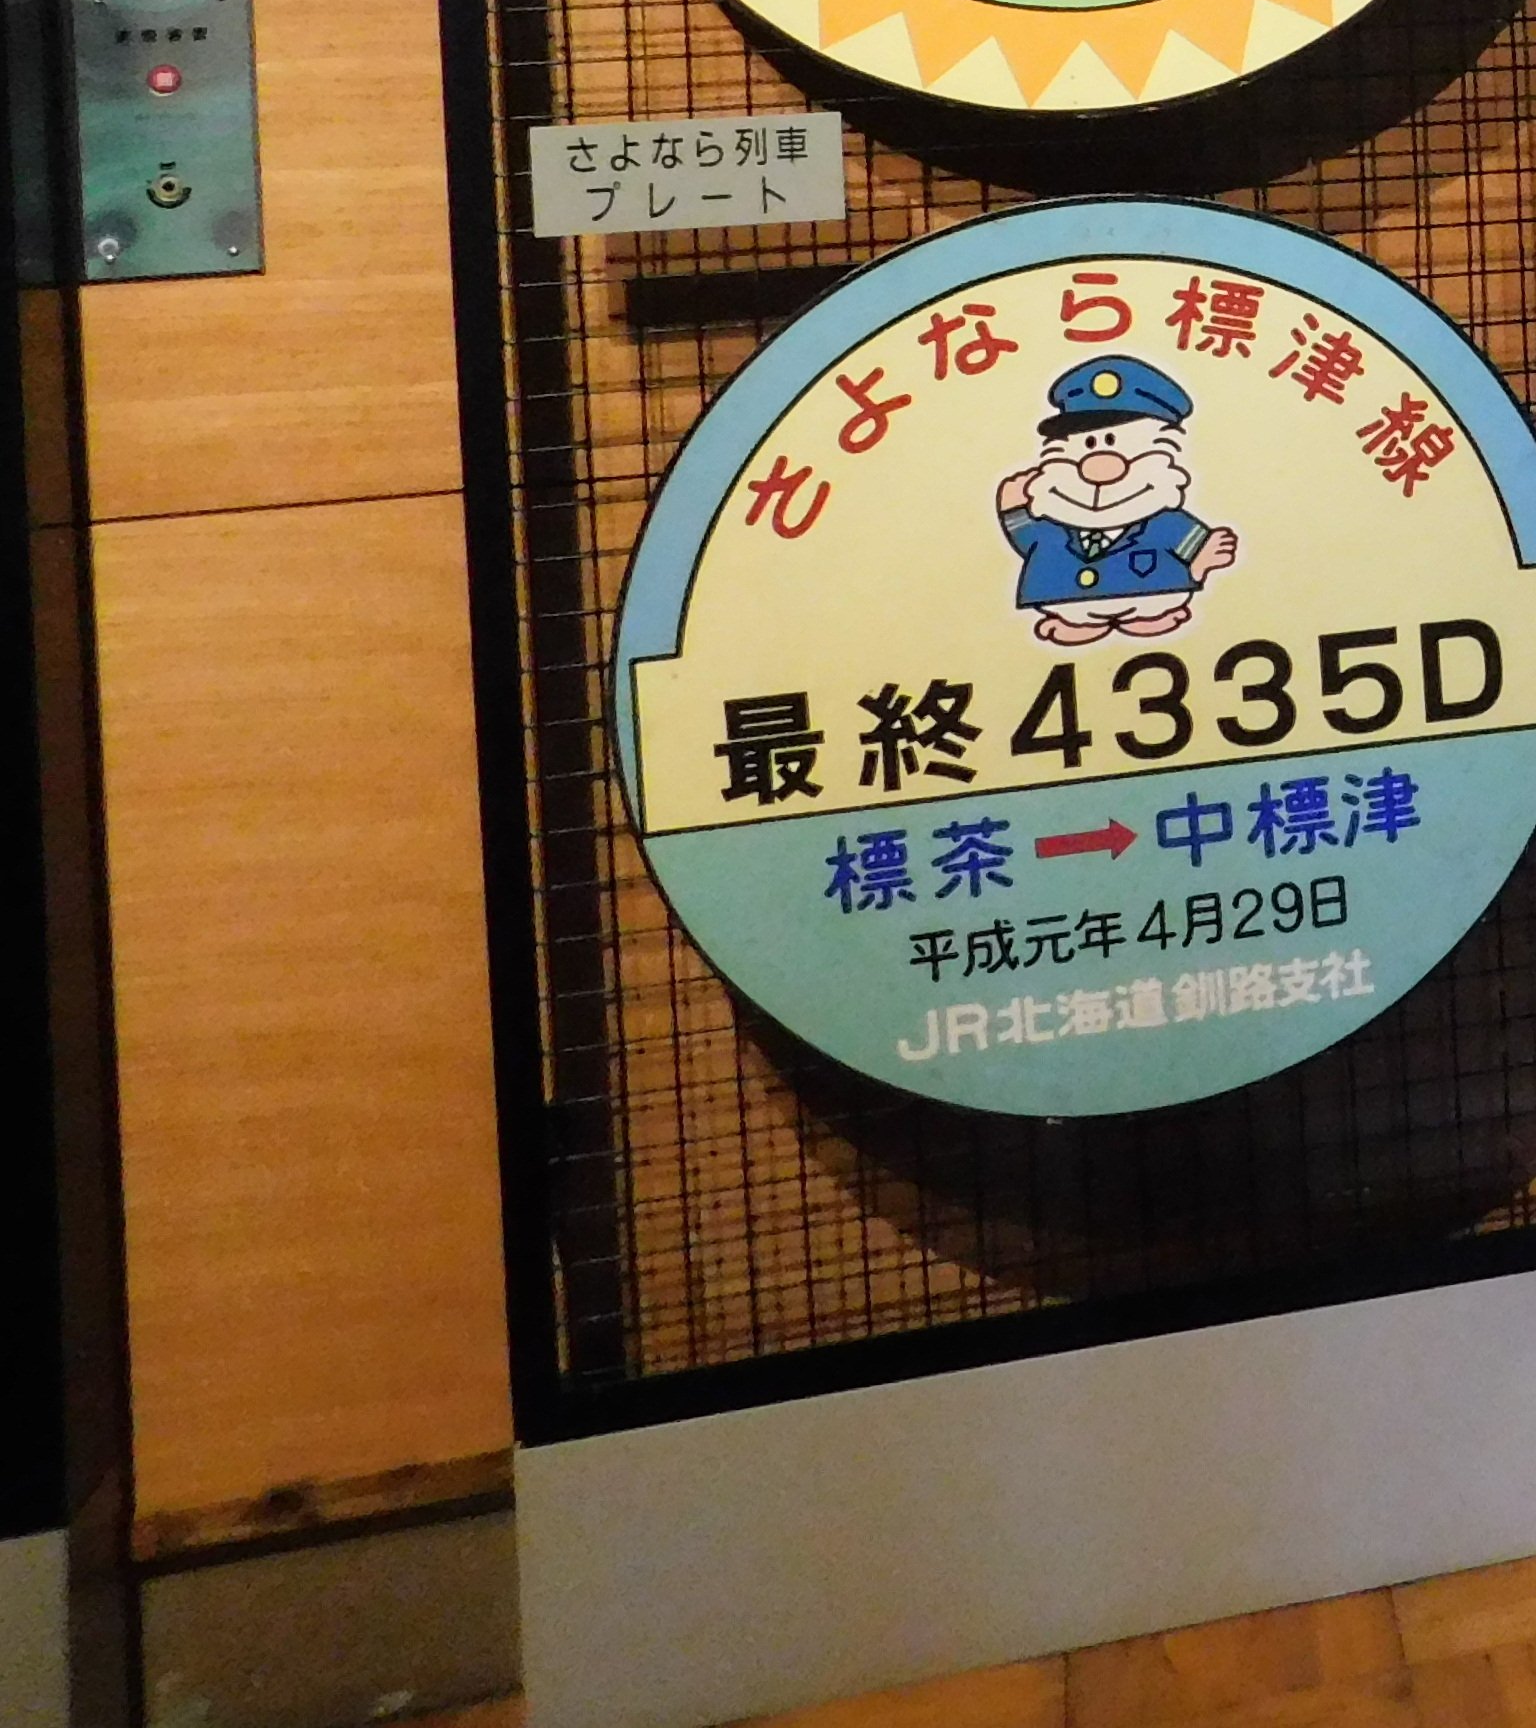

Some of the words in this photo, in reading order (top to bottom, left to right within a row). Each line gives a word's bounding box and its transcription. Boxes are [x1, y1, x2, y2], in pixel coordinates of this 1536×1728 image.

[567, 127, 808, 172] さよなら列車
[586, 176, 786, 221] プレート
[745, 271, 1457, 540] さよなら標津線
[713, 617, 1504, 805] 最終4335D
[824, 814, 1014, 915] 標茶
[1155, 766, 1422, 869] 中標津
[908, 876, 1348, 982] 平成元年4月29日
[897, 949, 1375, 1063] JR北海道釧路支社
